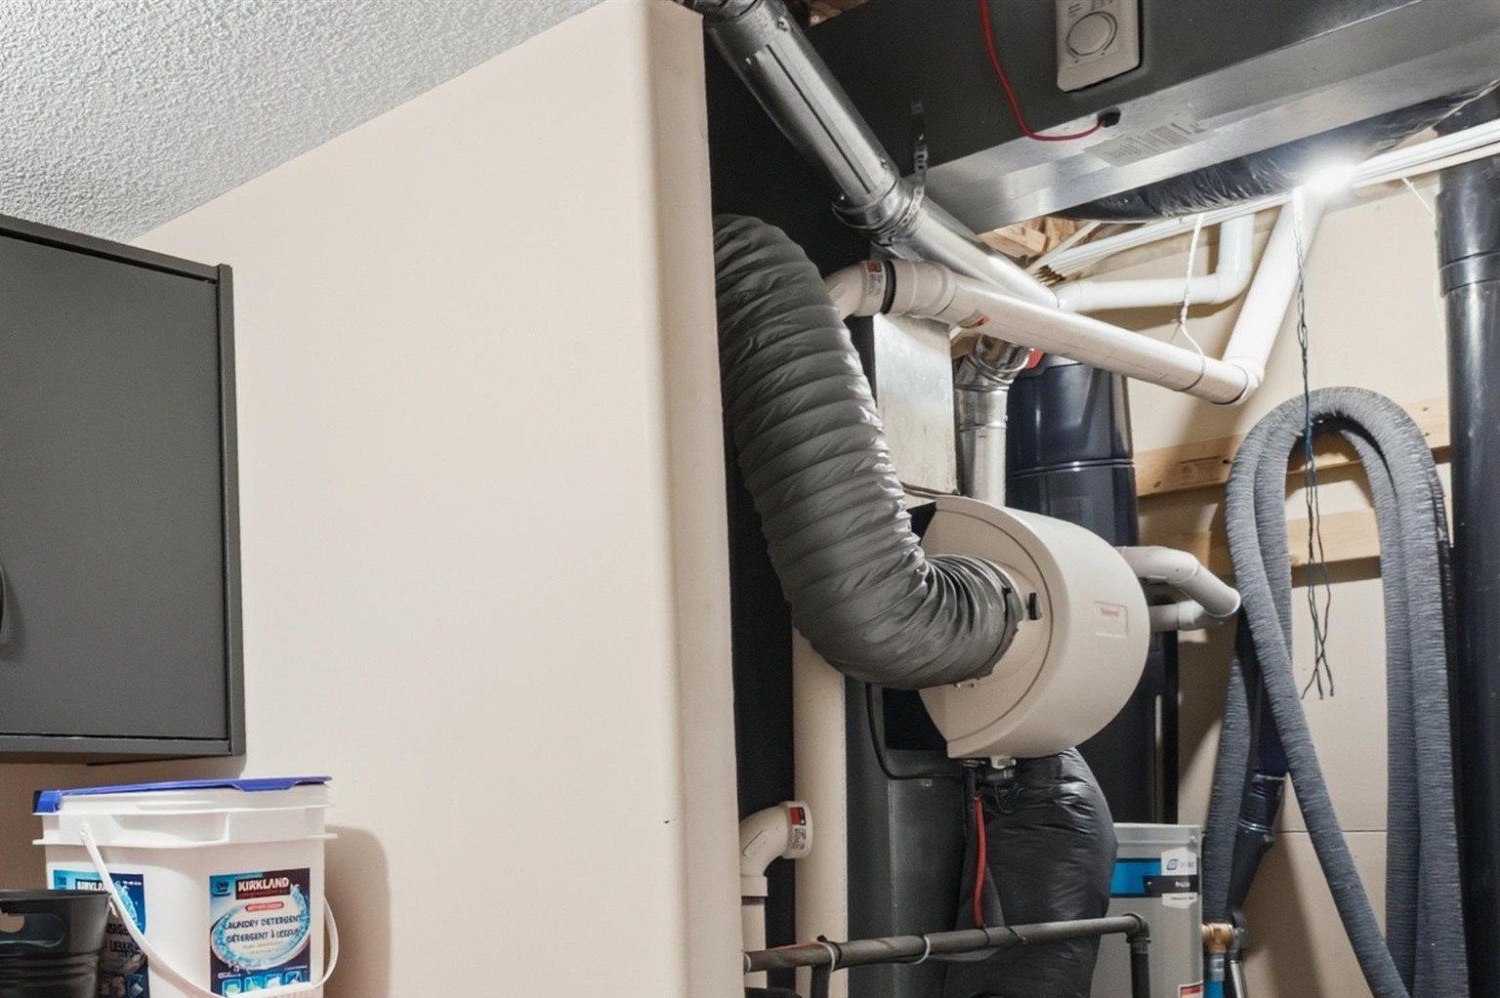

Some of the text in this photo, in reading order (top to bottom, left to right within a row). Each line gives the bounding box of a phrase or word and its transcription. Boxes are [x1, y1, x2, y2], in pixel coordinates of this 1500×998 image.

[238, 877, 290, 893] KIRKLAND
[223, 914, 301, 930] LAUNDRY DETERGENT
